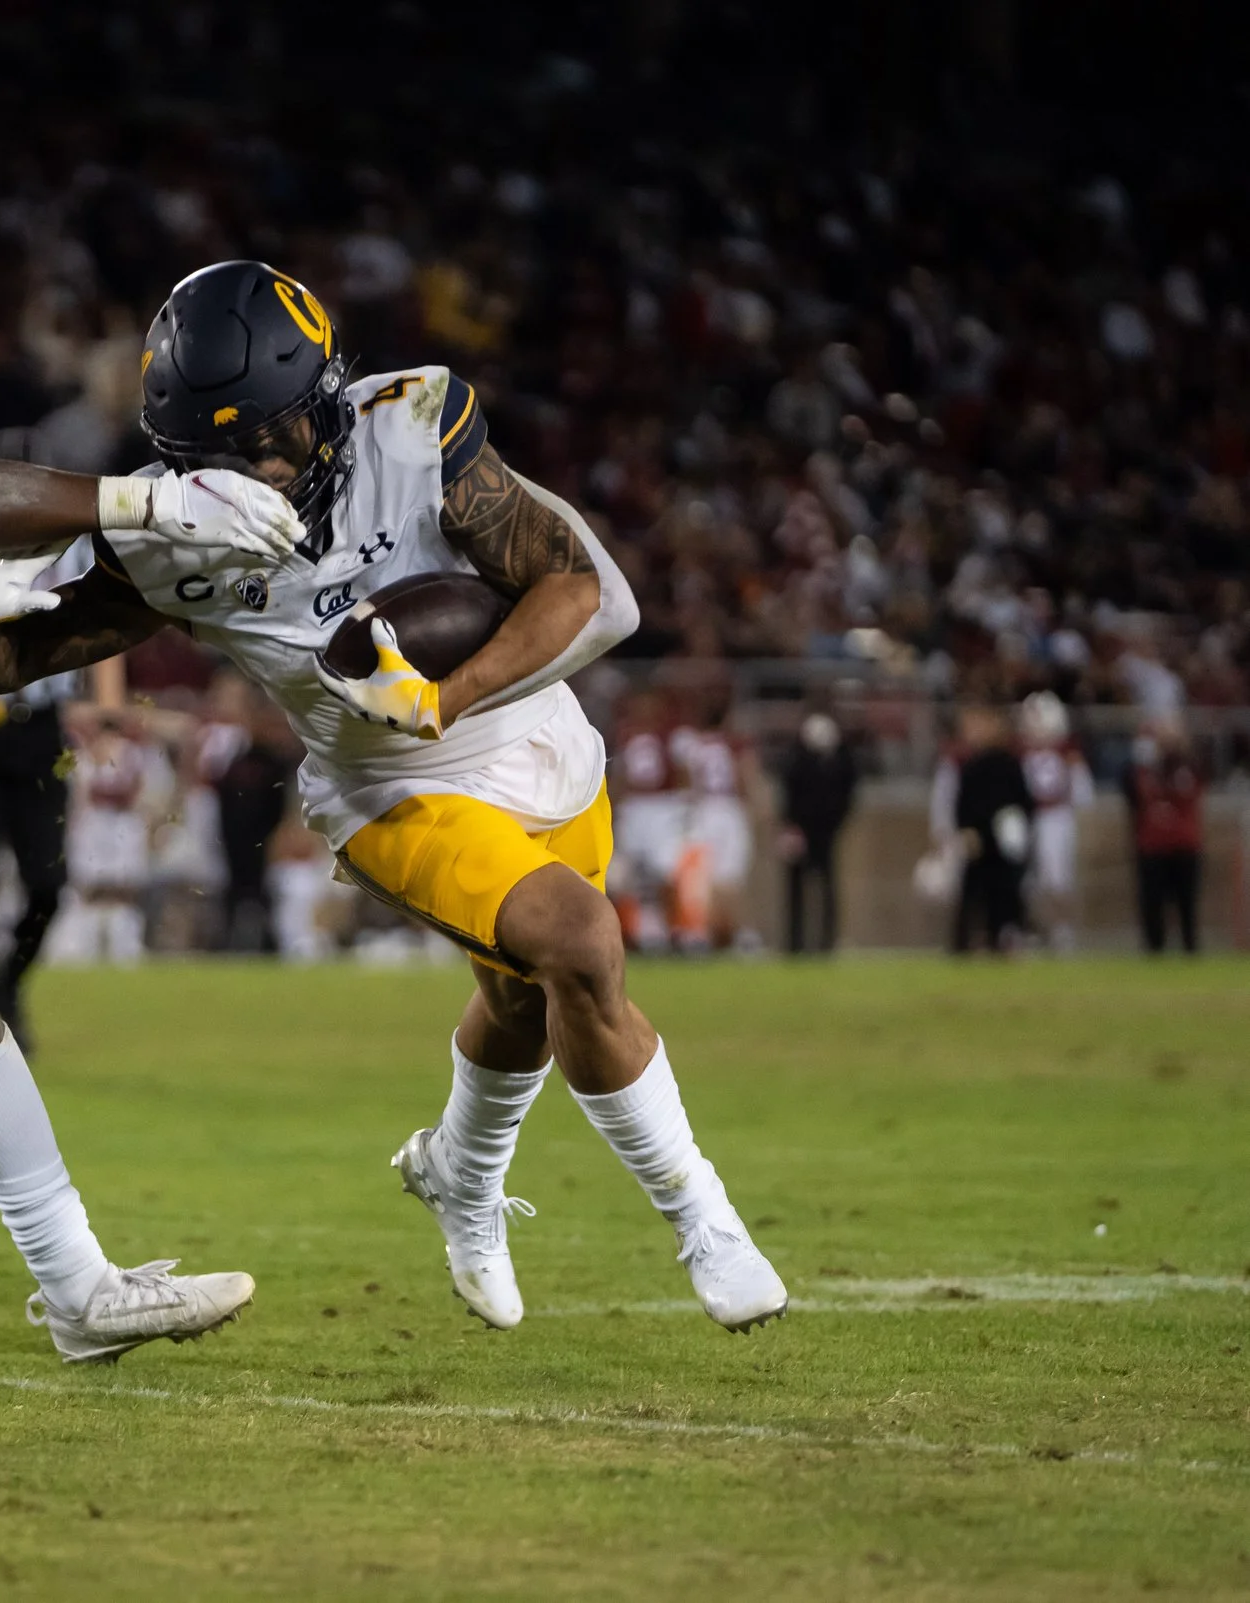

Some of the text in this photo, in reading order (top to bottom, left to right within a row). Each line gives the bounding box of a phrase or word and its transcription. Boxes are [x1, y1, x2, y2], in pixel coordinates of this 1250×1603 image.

[359, 376, 425, 416] 4
[175, 574, 215, 601] C
[313, 583, 358, 625] Cal
